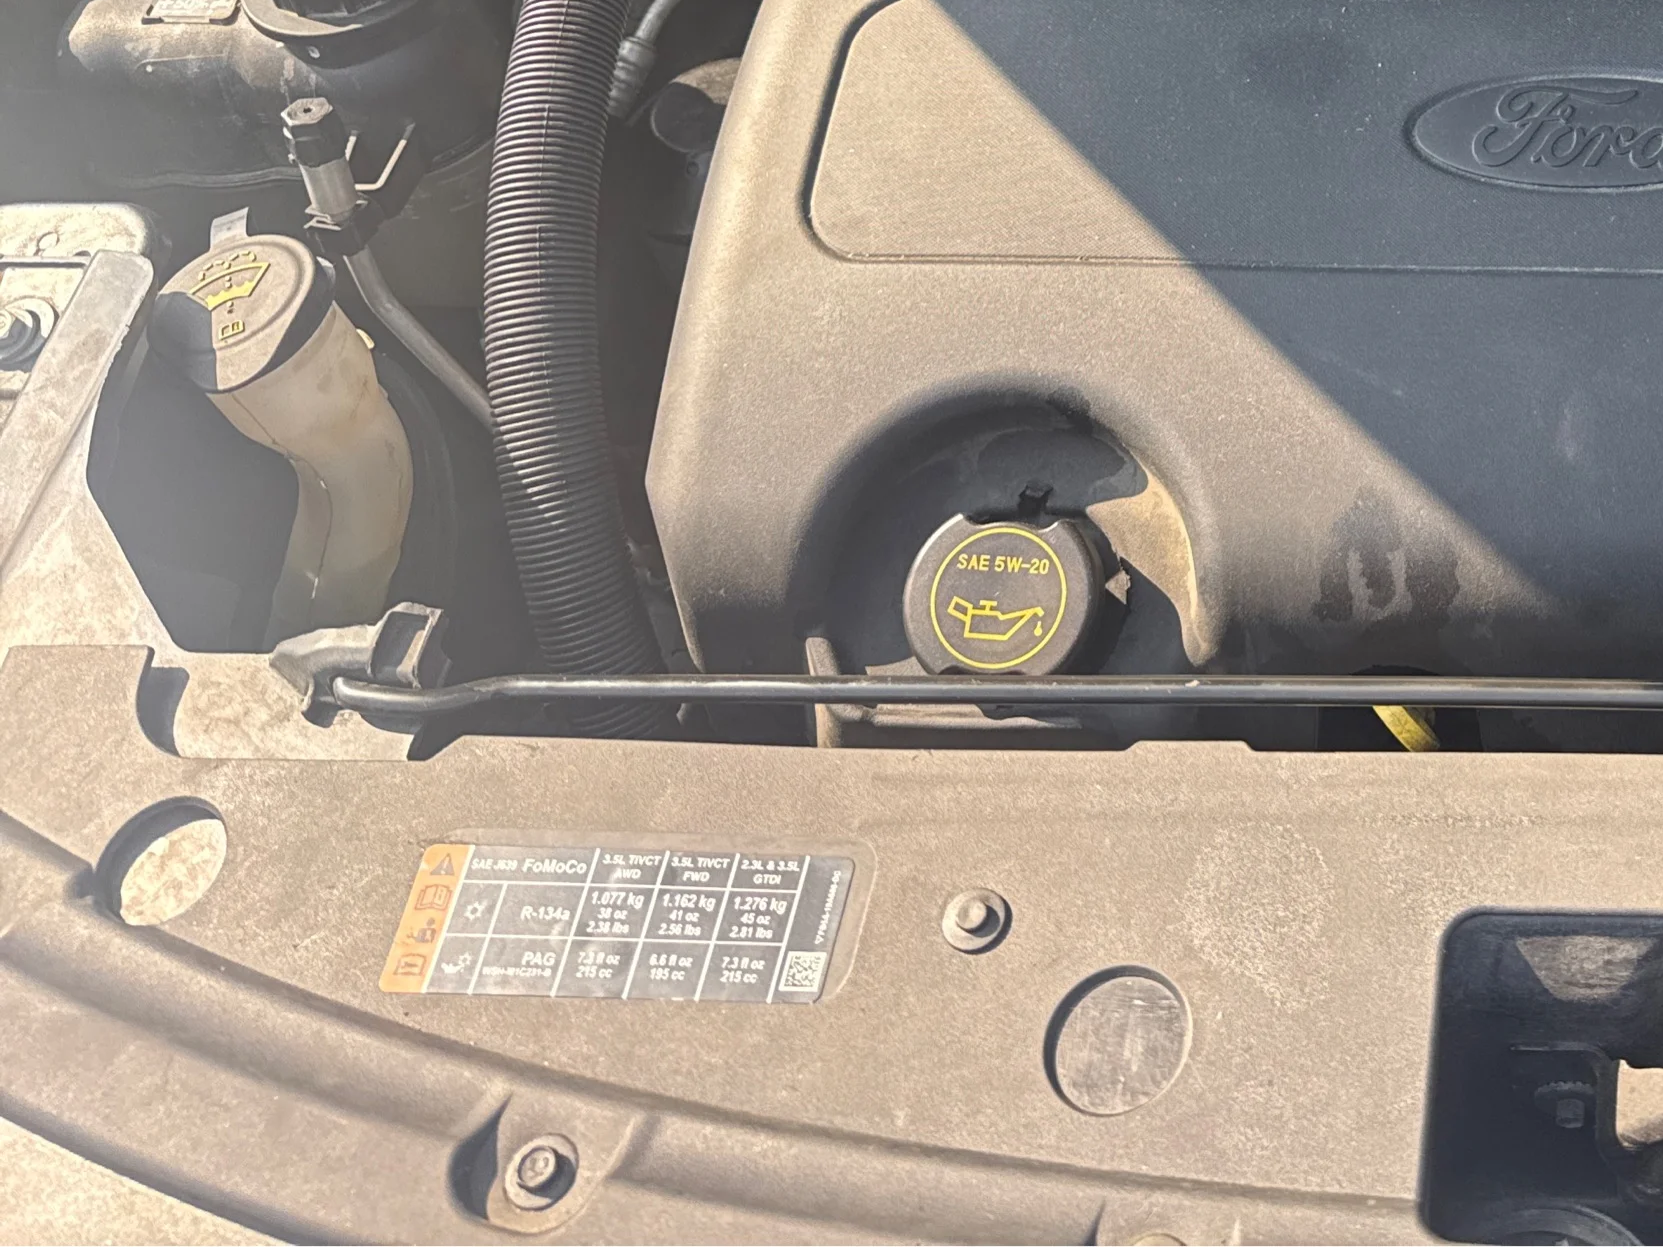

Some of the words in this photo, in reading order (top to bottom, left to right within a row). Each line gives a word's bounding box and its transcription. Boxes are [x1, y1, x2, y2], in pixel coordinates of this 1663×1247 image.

[957, 554, 990, 571] SAE
[994, 556, 1050, 575] 5W-20
[471, 858, 493, 870] SAE
[522, 858, 587, 874] FoMoCo
[603, 854, 626, 865] 3.5L
[671, 857, 694, 868] 3.5L
[741, 860, 764, 870] 2.3L
[766, 861, 775, 870] &
[777, 861, 800, 872] 3.5L
[614, 868, 641, 879] AWD
[682, 871, 710, 882] FWD
[753, 874, 781, 884] GTDI
[591, 891, 626, 905] 1.077
[627, 892, 645, 909] kg
[663, 893, 697, 908] 1.162
[698, 894, 716, 912] kg
[734, 896, 768, 911] 1.276
[770, 897, 787, 915] kg
[520, 905, 570, 921] R-134a
[597, 908, 612, 919] 38
[614, 910, 628, 920] oz
[669, 910, 682, 921] 41
[685, 912, 700, 922] oz
[741, 913, 755, 924] 45
[756, 916, 771, 925] oz
[586, 921, 611, 933] 2.38
[612, 922, 630, 933] lbs
[658, 923, 682, 935] 2.56
[684, 924, 701, 936] lbs
[729, 926, 753, 938] 2.81
[755, 927, 773, 939] lbs
[521, 951, 556, 966] PAG
[594, 952, 605, 964] fl
[606, 955, 620, 965] oz
[650, 954, 667, 967] 6.6
[668, 954, 678, 967] fl
[678, 957, 693, 968] oz
[721, 956, 739, 970] 7.3
[740, 957, 750, 969] fl
[751, 960, 766, 970] oz
[576, 965, 597, 978] 215
[599, 968, 613, 978] cc
[650, 967, 670, 980] 195
[671, 970, 685, 981] cc
[720, 970, 742, 983] 215
[742, 973, 759, 984] cc
